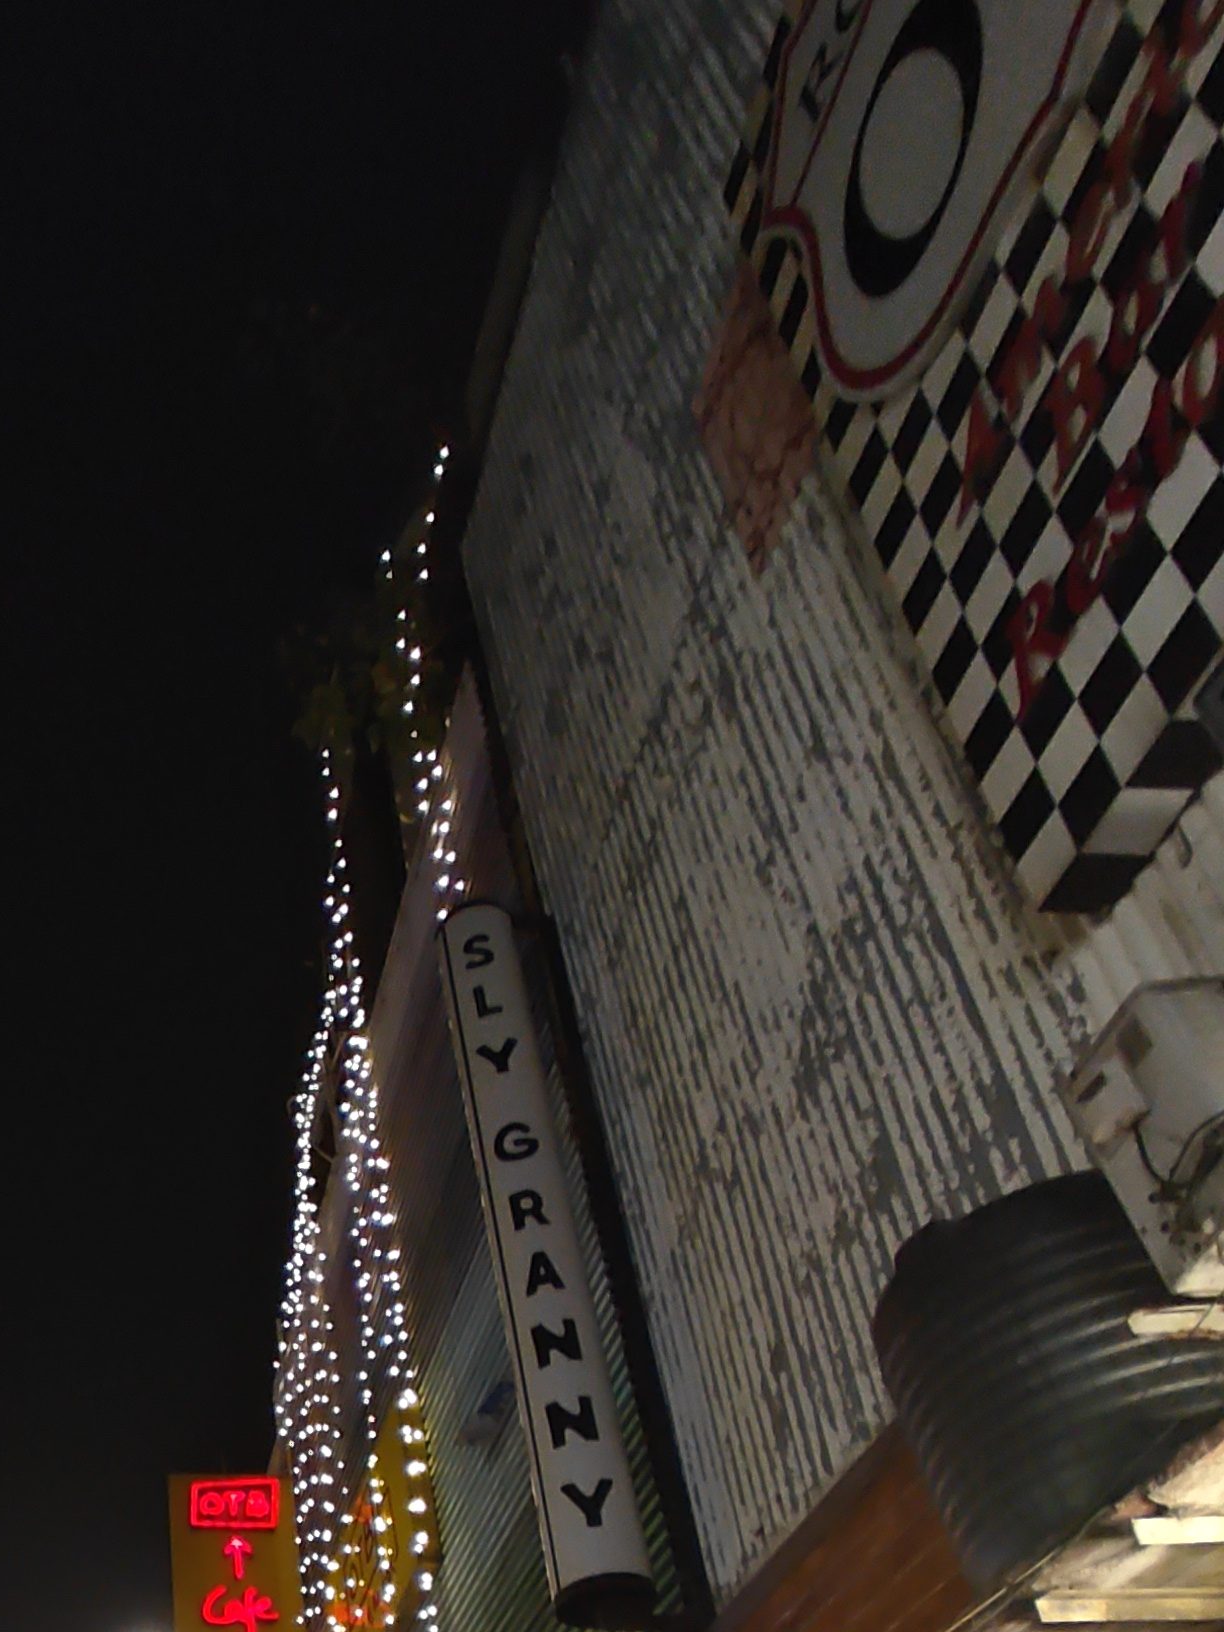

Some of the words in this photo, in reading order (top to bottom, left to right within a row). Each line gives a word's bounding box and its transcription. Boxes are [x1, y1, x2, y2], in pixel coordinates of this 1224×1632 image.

[463, 933, 521, 1073] SLY
[494, 1121, 616, 1529] GRANNY
[199, 1491, 270, 1517] OTB
